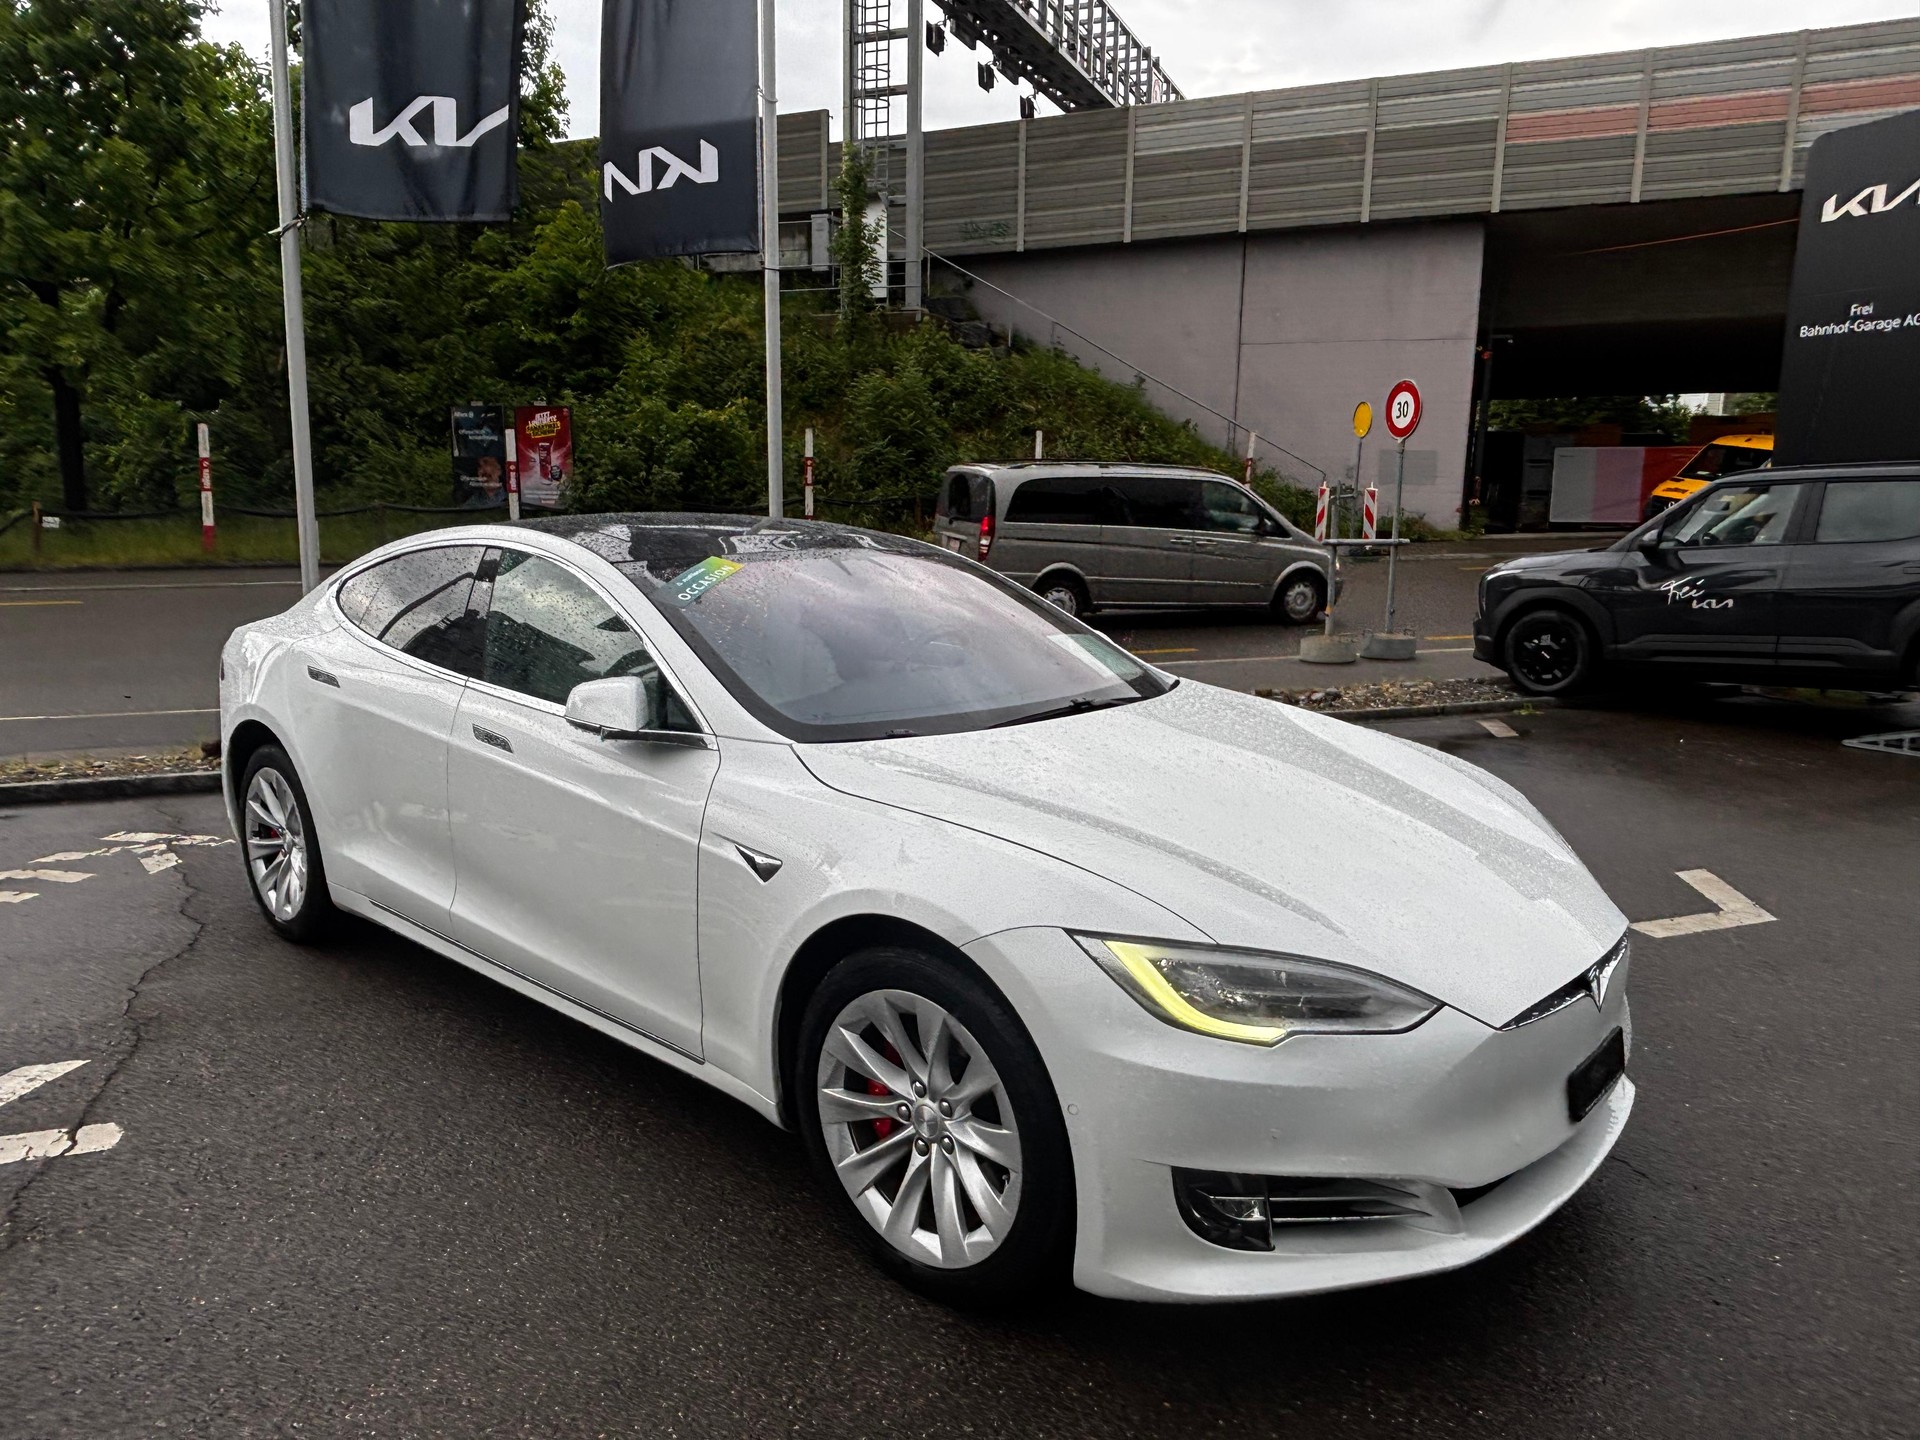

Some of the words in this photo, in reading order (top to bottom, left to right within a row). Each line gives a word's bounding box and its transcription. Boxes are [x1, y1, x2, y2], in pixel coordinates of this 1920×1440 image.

[1850, 302, 1874, 316] Frei
[1800, 316, 1901, 338] Bahnhof-Garage
[1395, 400, 1409, 419] 30
[677, 564, 735, 601] OCCASION
[1660, 576, 1705, 605] Frei
